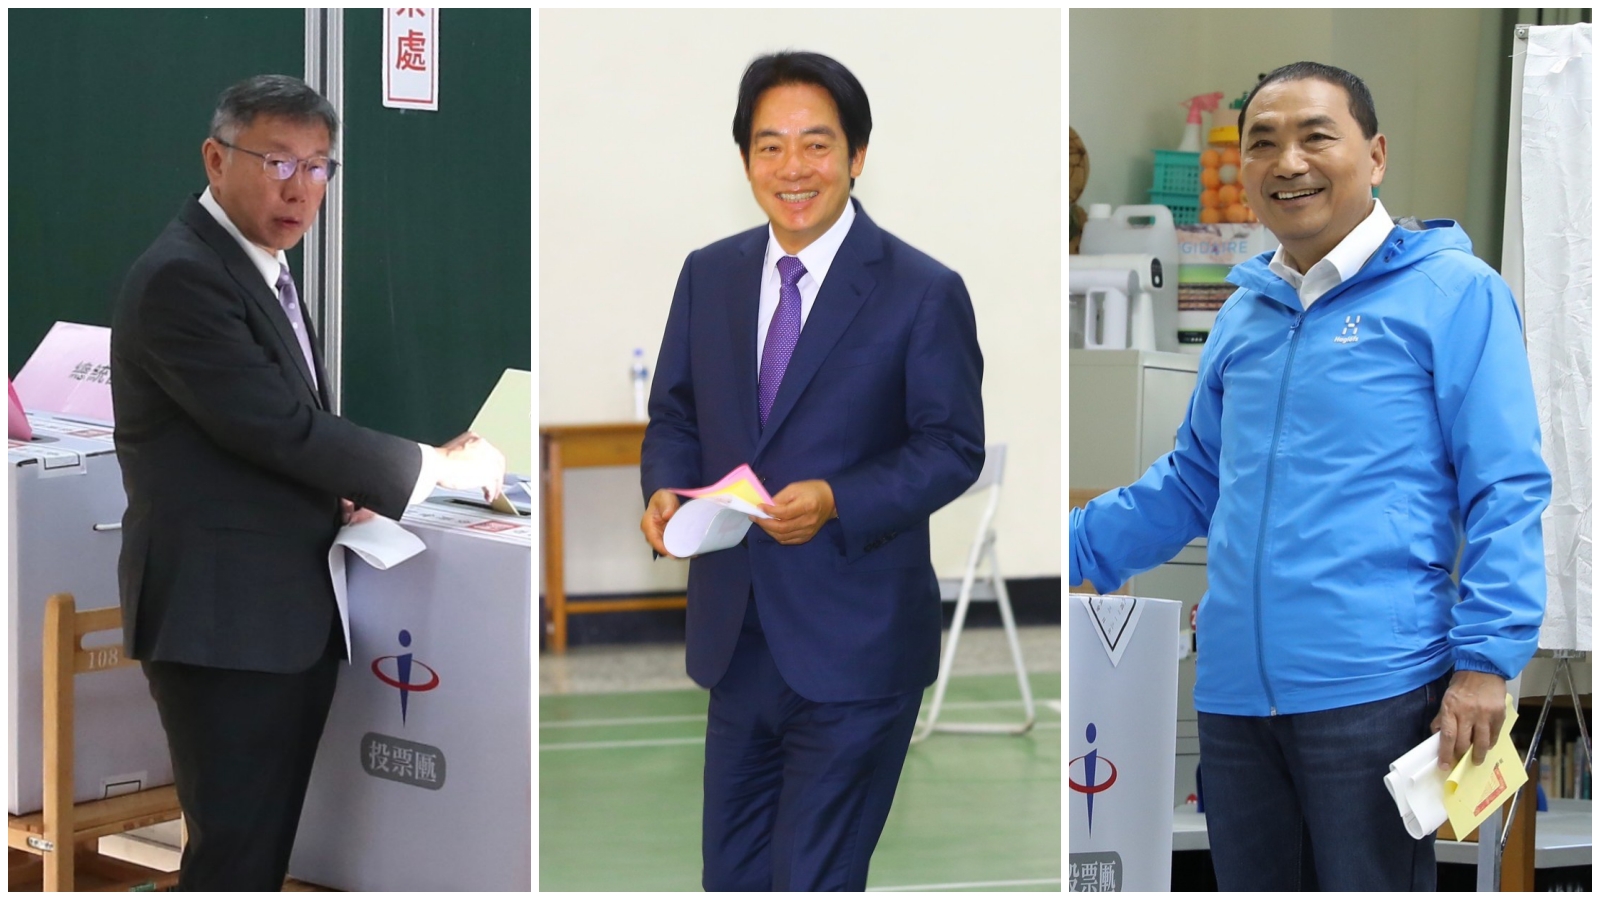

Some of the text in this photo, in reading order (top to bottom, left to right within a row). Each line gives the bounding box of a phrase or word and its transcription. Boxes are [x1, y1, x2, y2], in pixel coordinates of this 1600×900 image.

[1180, 241, 1249, 255] GIDAIRE
[69, 360, 111, 385] 總統
[88, 647, 118, 669] 108
[369, 740, 437, 782] 投票匭
